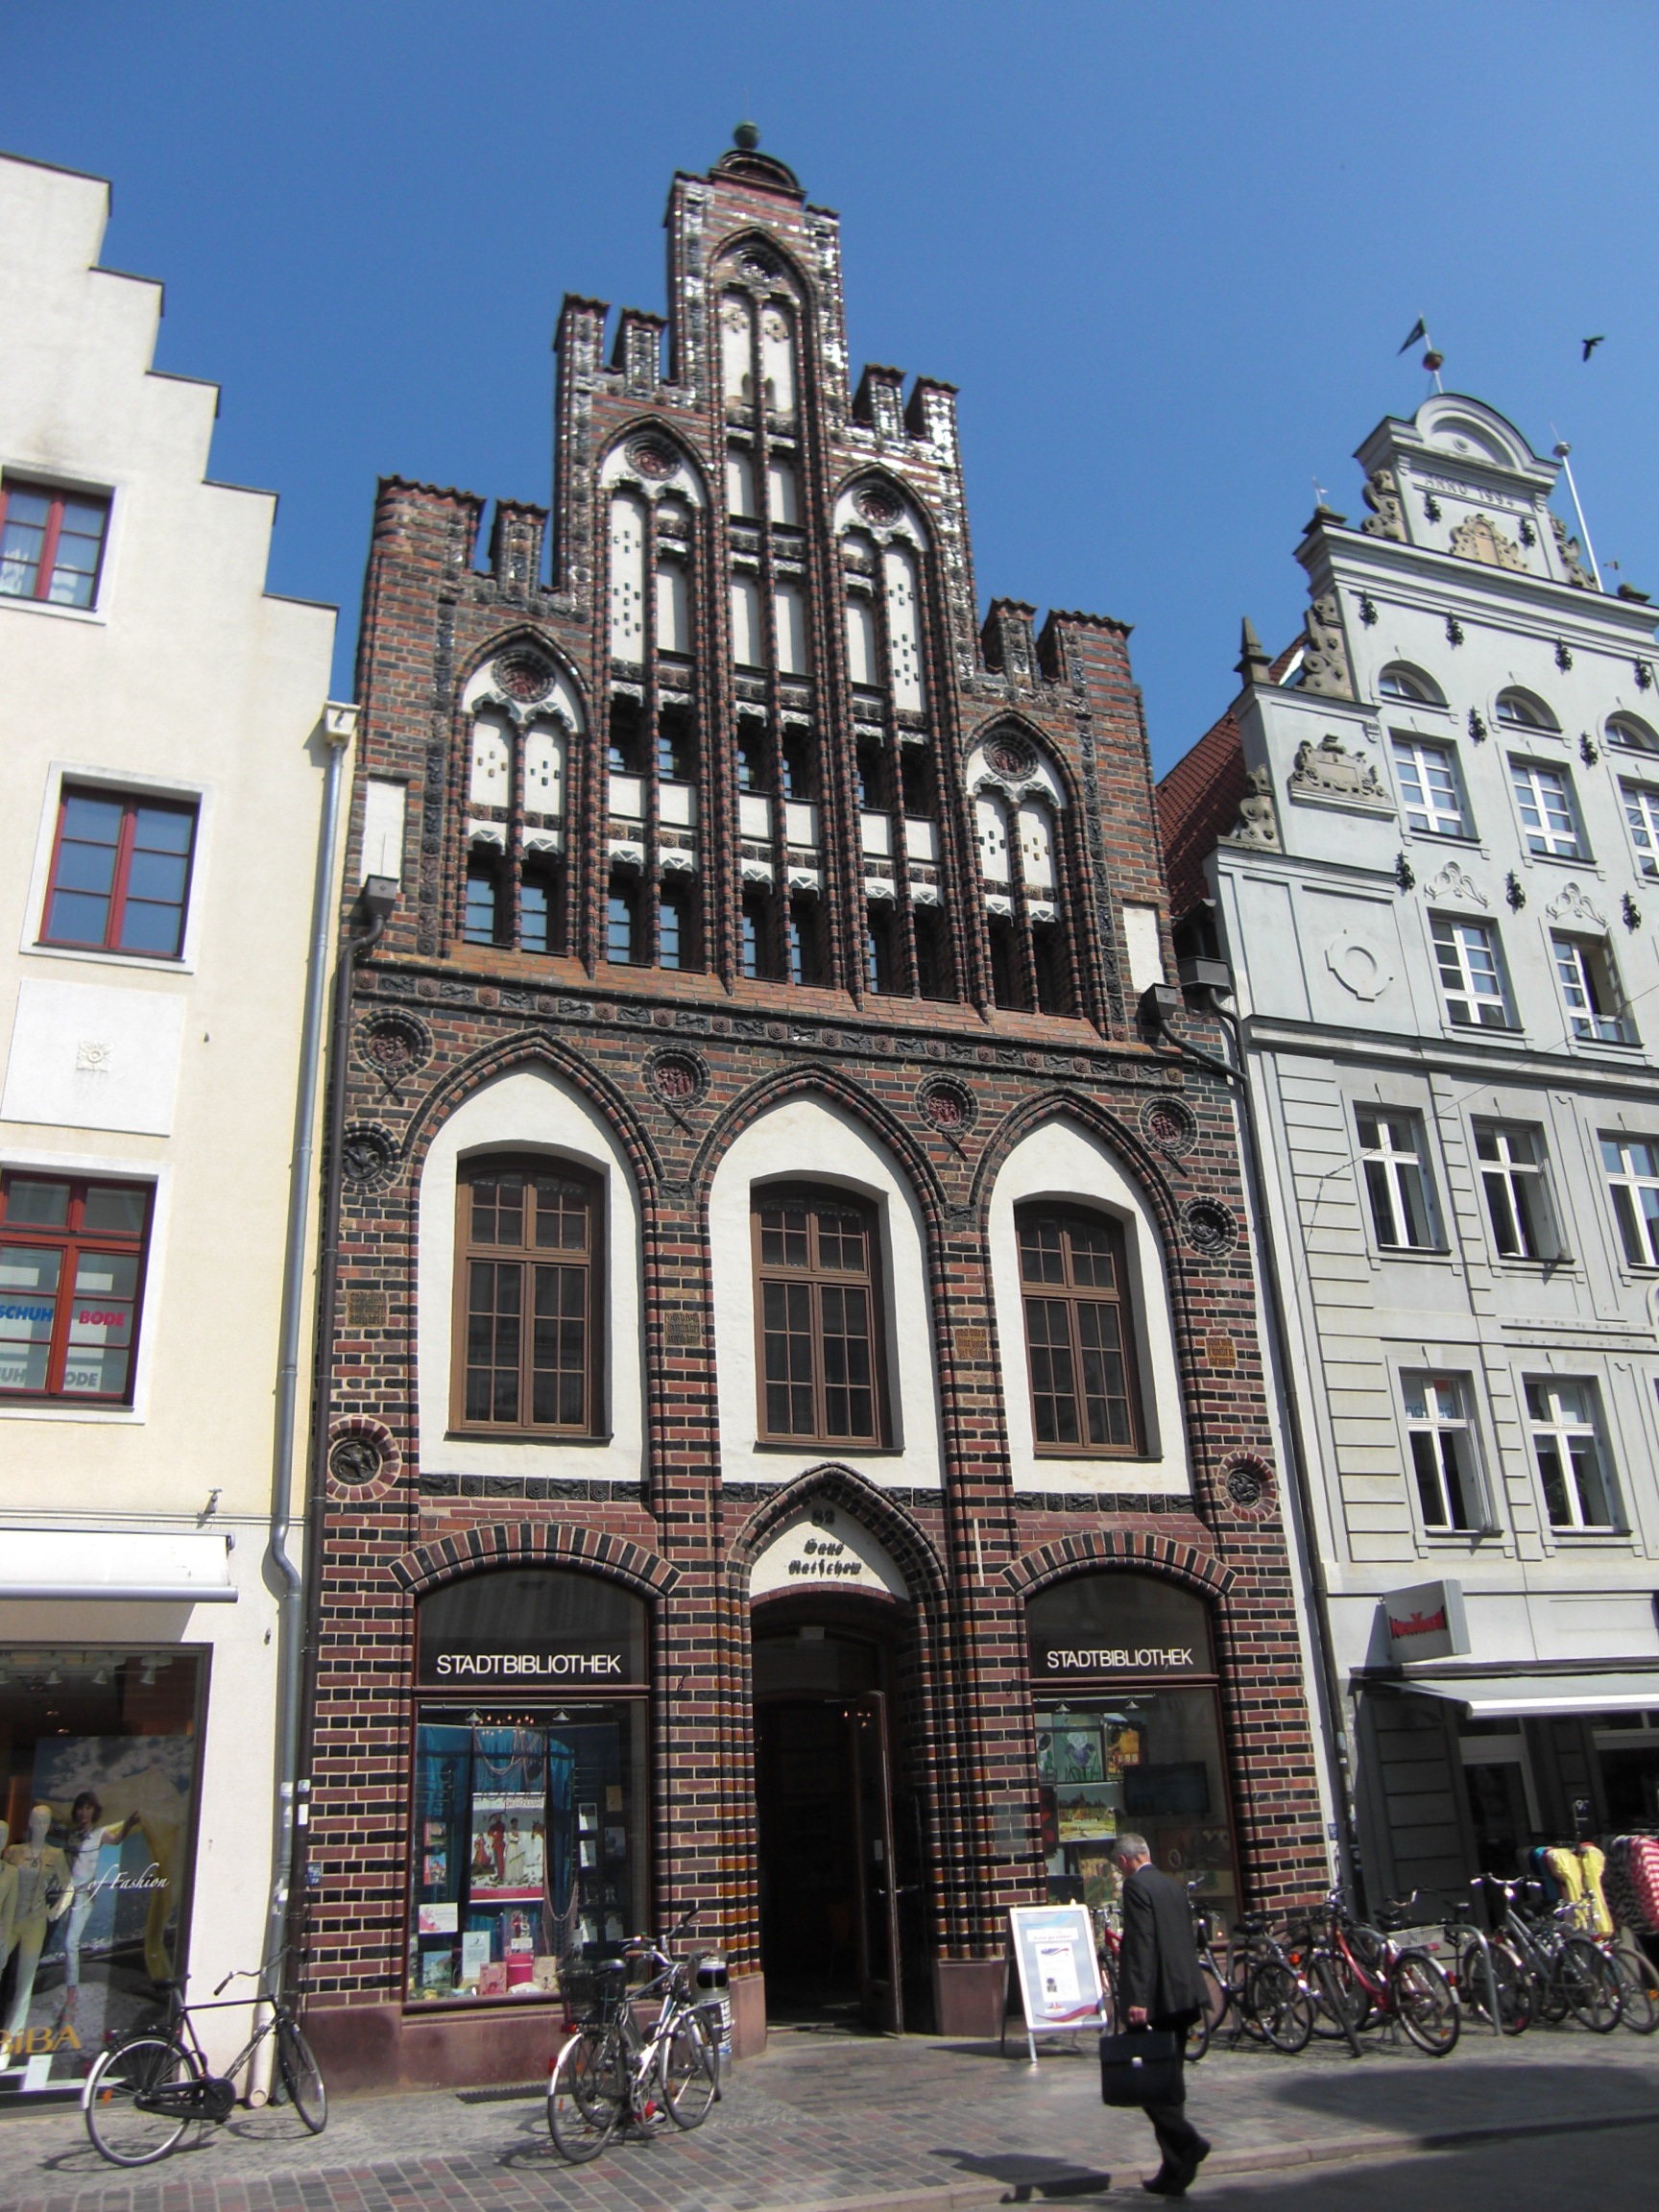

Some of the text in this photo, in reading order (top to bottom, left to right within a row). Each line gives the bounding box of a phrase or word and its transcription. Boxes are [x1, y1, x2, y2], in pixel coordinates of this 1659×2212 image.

[1425, 474, 1468, 495] ANNO
[79, 1310, 126, 1327] BODE
[804, 1538, 845, 1556] Haus
[436, 1654, 622, 1674] STADTBIBLIOTHEK
[1046, 1648, 1193, 1669] STADTBIBLIOTHEK
[71, 1863, 119, 1911] of
[109, 1863, 170, 1889] Fashion
